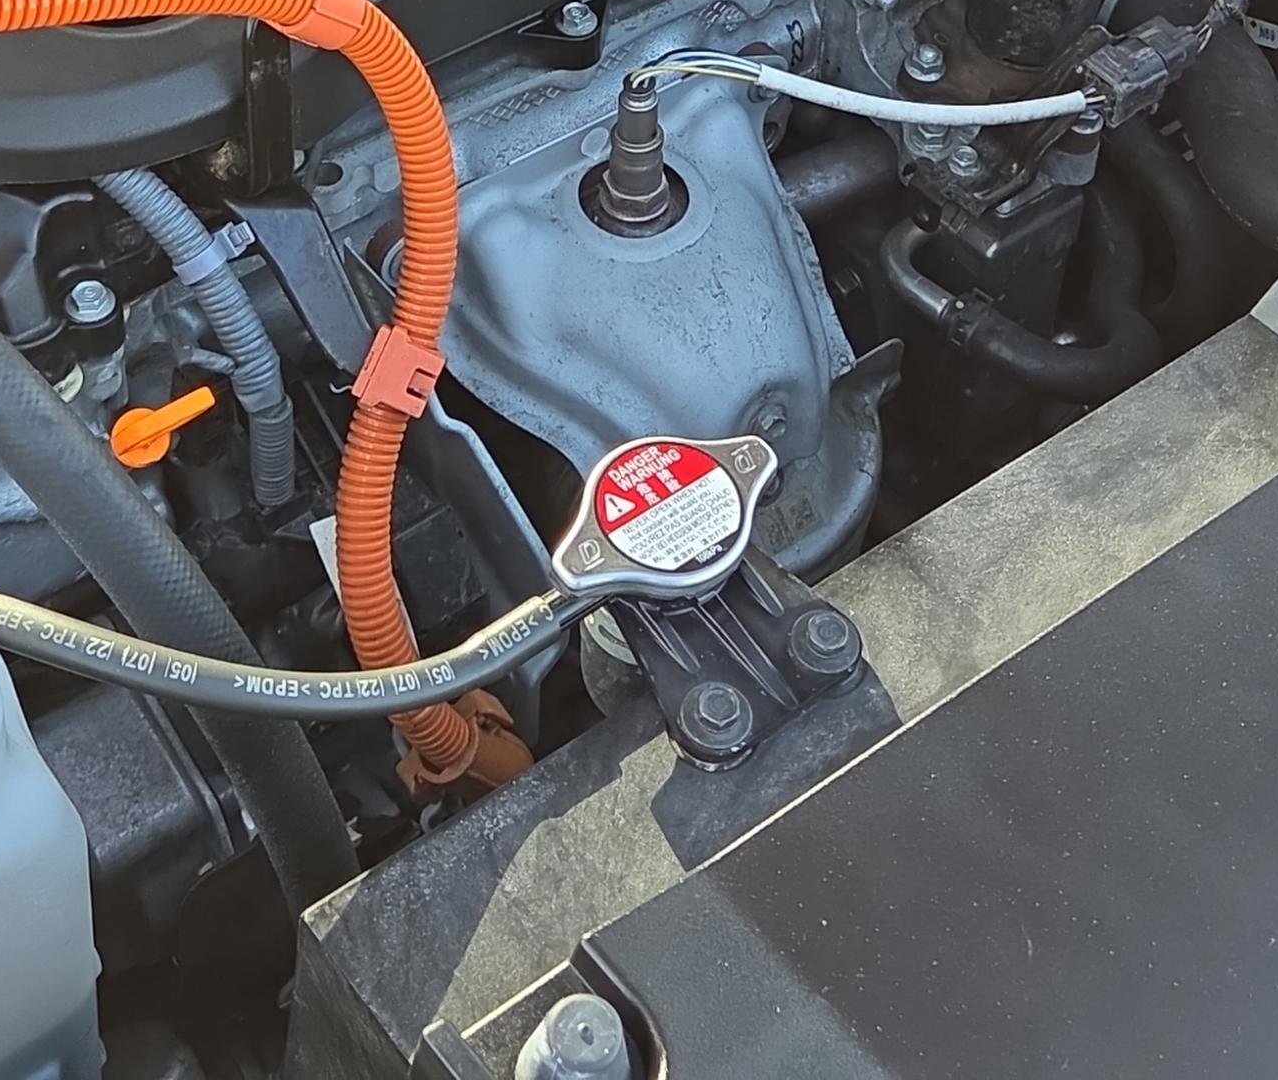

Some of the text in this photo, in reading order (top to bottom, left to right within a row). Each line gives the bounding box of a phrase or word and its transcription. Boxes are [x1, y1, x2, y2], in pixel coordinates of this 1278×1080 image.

[607, 445, 662, 482] DANGER
[616, 448, 683, 492] WARNUNG
[622, 515, 650, 535] NEVER
[649, 501, 672, 518] OPEN
[672, 487, 695, 504] WHEN
[665, 520, 681, 533] PAS
[680, 503, 706, 523] QUAND
[629, 532, 642, 542] Hot
[39, 624, 78, 650] TPC
[478, 612, 540, 662] >EPDM<
[233, 674, 312, 699] >EPDM<
[319, 679, 357, 699] TPC
